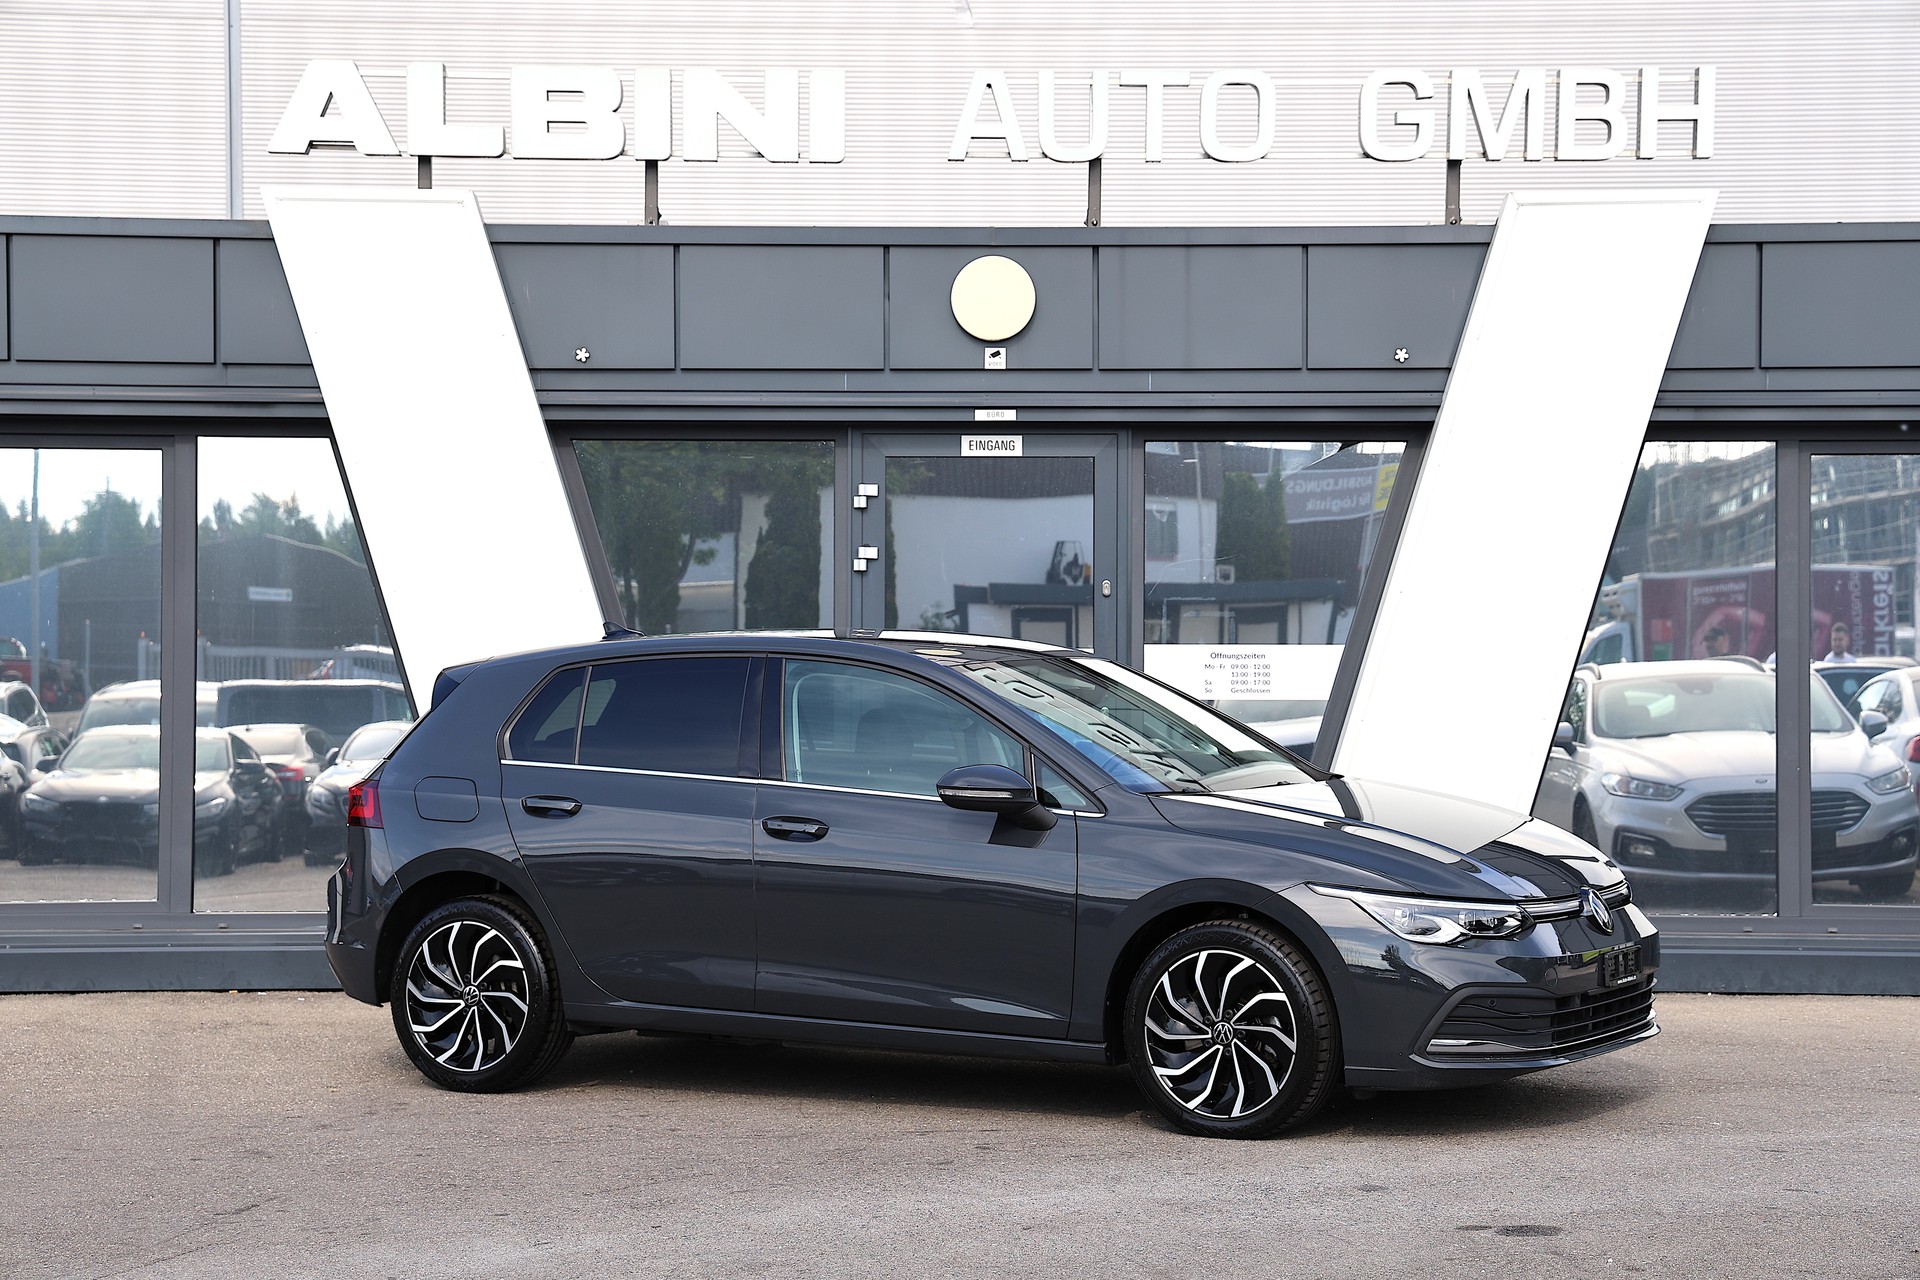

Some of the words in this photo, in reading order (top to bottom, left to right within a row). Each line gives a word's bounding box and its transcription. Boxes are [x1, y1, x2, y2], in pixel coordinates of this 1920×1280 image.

[267, 59, 846, 164] ALBINI
[947, 66, 1277, 163] AUTO
[1358, 64, 1717, 163] GMBH
[968, 439, 1016, 451] EINGANG
